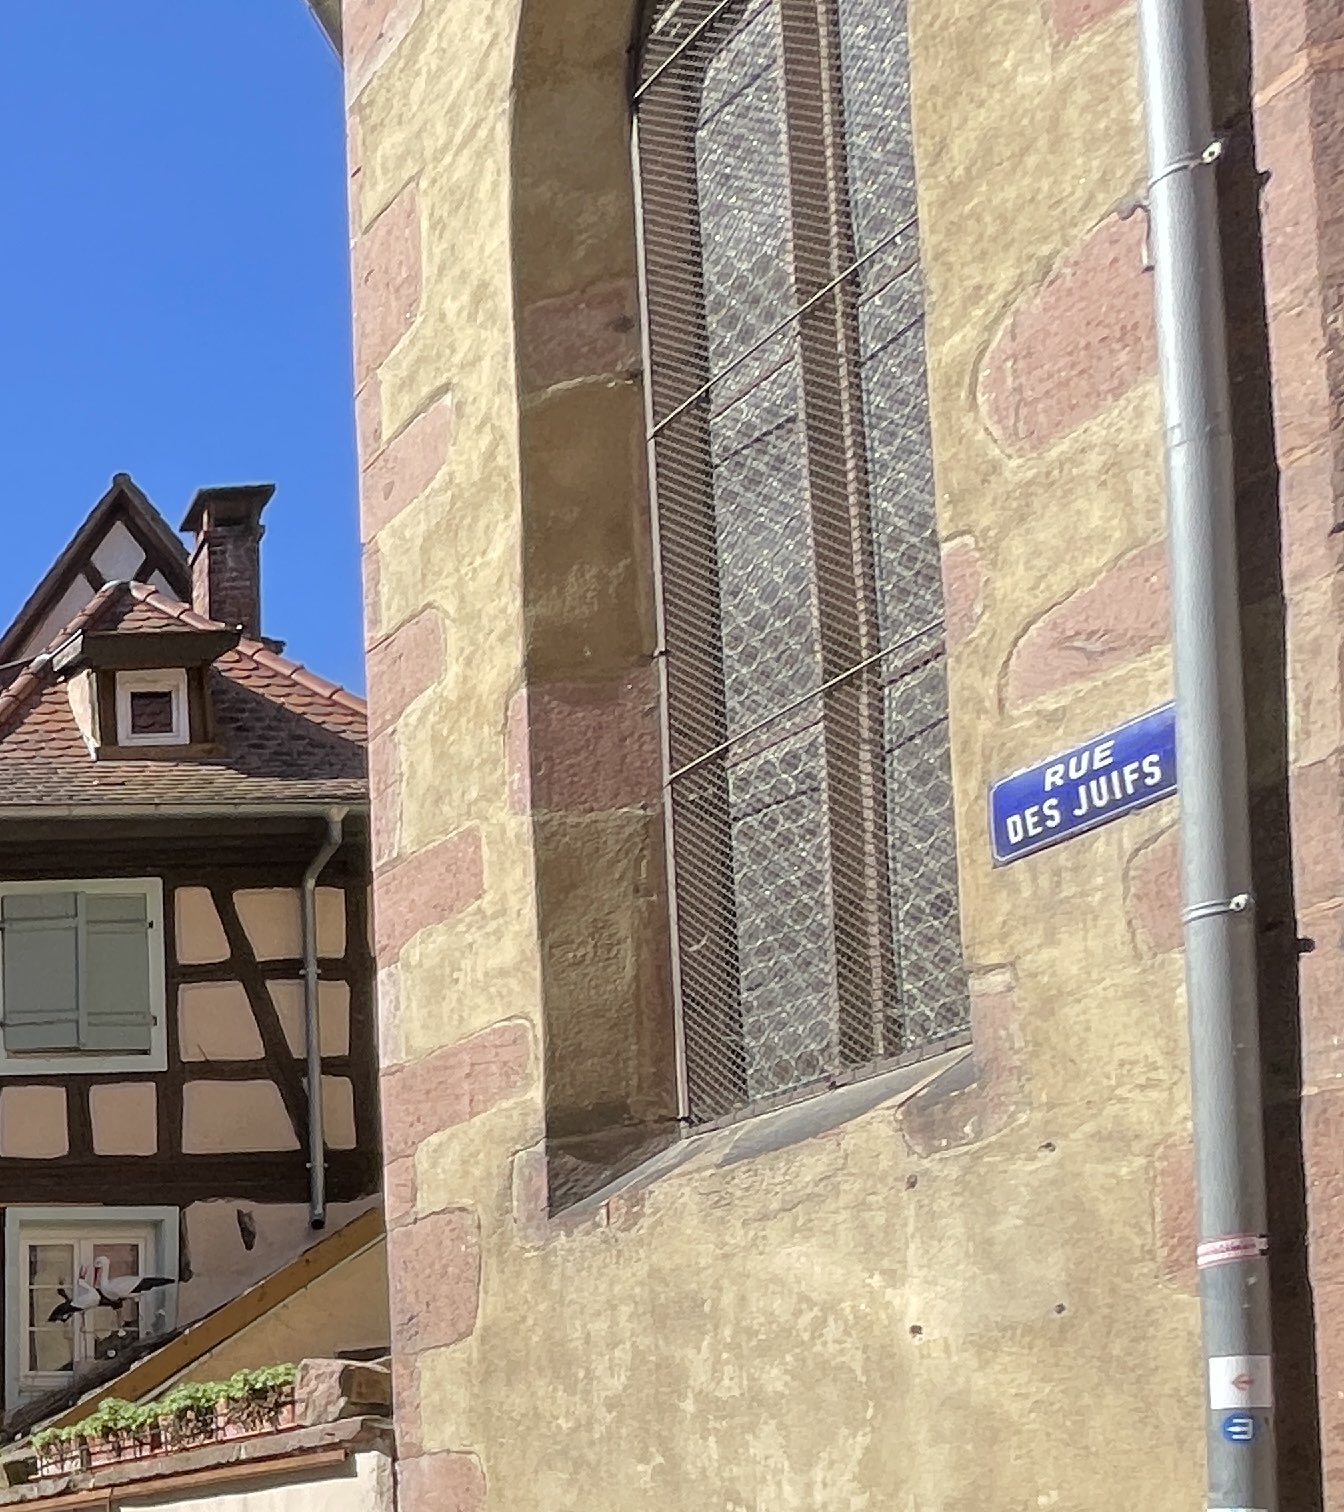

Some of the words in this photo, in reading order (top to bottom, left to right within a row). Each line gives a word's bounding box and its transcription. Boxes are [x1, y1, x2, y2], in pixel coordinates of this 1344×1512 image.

[1006, 798, 1061, 844] DES
[1073, 754, 1162, 816] JUIFS
[1044, 740, 1115, 791] RUE
